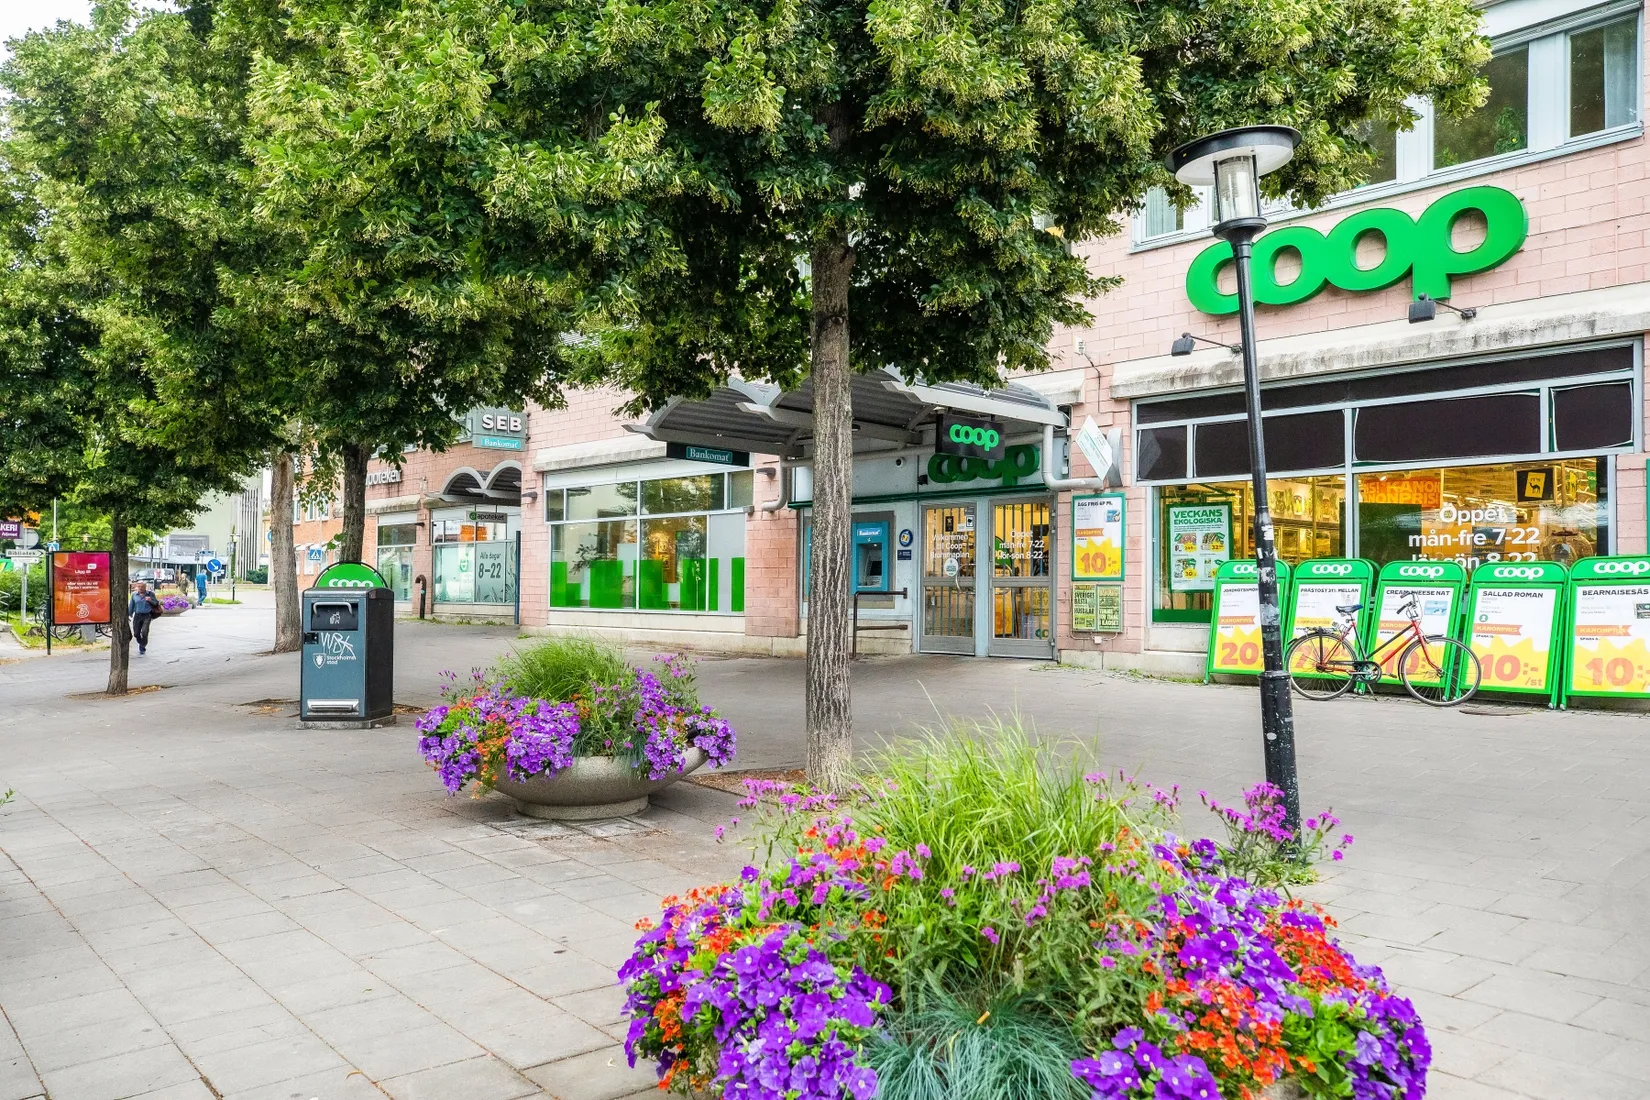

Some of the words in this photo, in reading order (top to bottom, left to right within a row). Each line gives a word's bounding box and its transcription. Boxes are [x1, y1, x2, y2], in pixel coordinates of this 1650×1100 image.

[1186, 186, 1528, 315] coop
[949, 424, 999, 452] coop
[689, 448, 729, 462] Bankomat
[928, 444, 1040, 488] coop
[365, 466, 401, 487] poteket
[477, 512, 505, 520] apoteket
[1173, 509, 1223, 518] VECKANS
[1439, 502, 1507, 526] Öppet
[1173, 517, 1225, 525] EKOLOGISKA.
[1408, 529, 1487, 547] mån-fre
[1492, 527, 1540, 545] 7-22
[1028, 540, 1045, 548] 7-22
[1026, 551, 1043, 559] 8-22
[1312, 564, 1353, 576] coop
[1399, 566, 1445, 579] coop
[1493, 566, 1544, 580] coop
[1593, 560, 1650, 576] coop
[1582, 587, 1649, 596] BEARNAISESÅS
[1476, 625, 1519, 633] KANONPRIS
